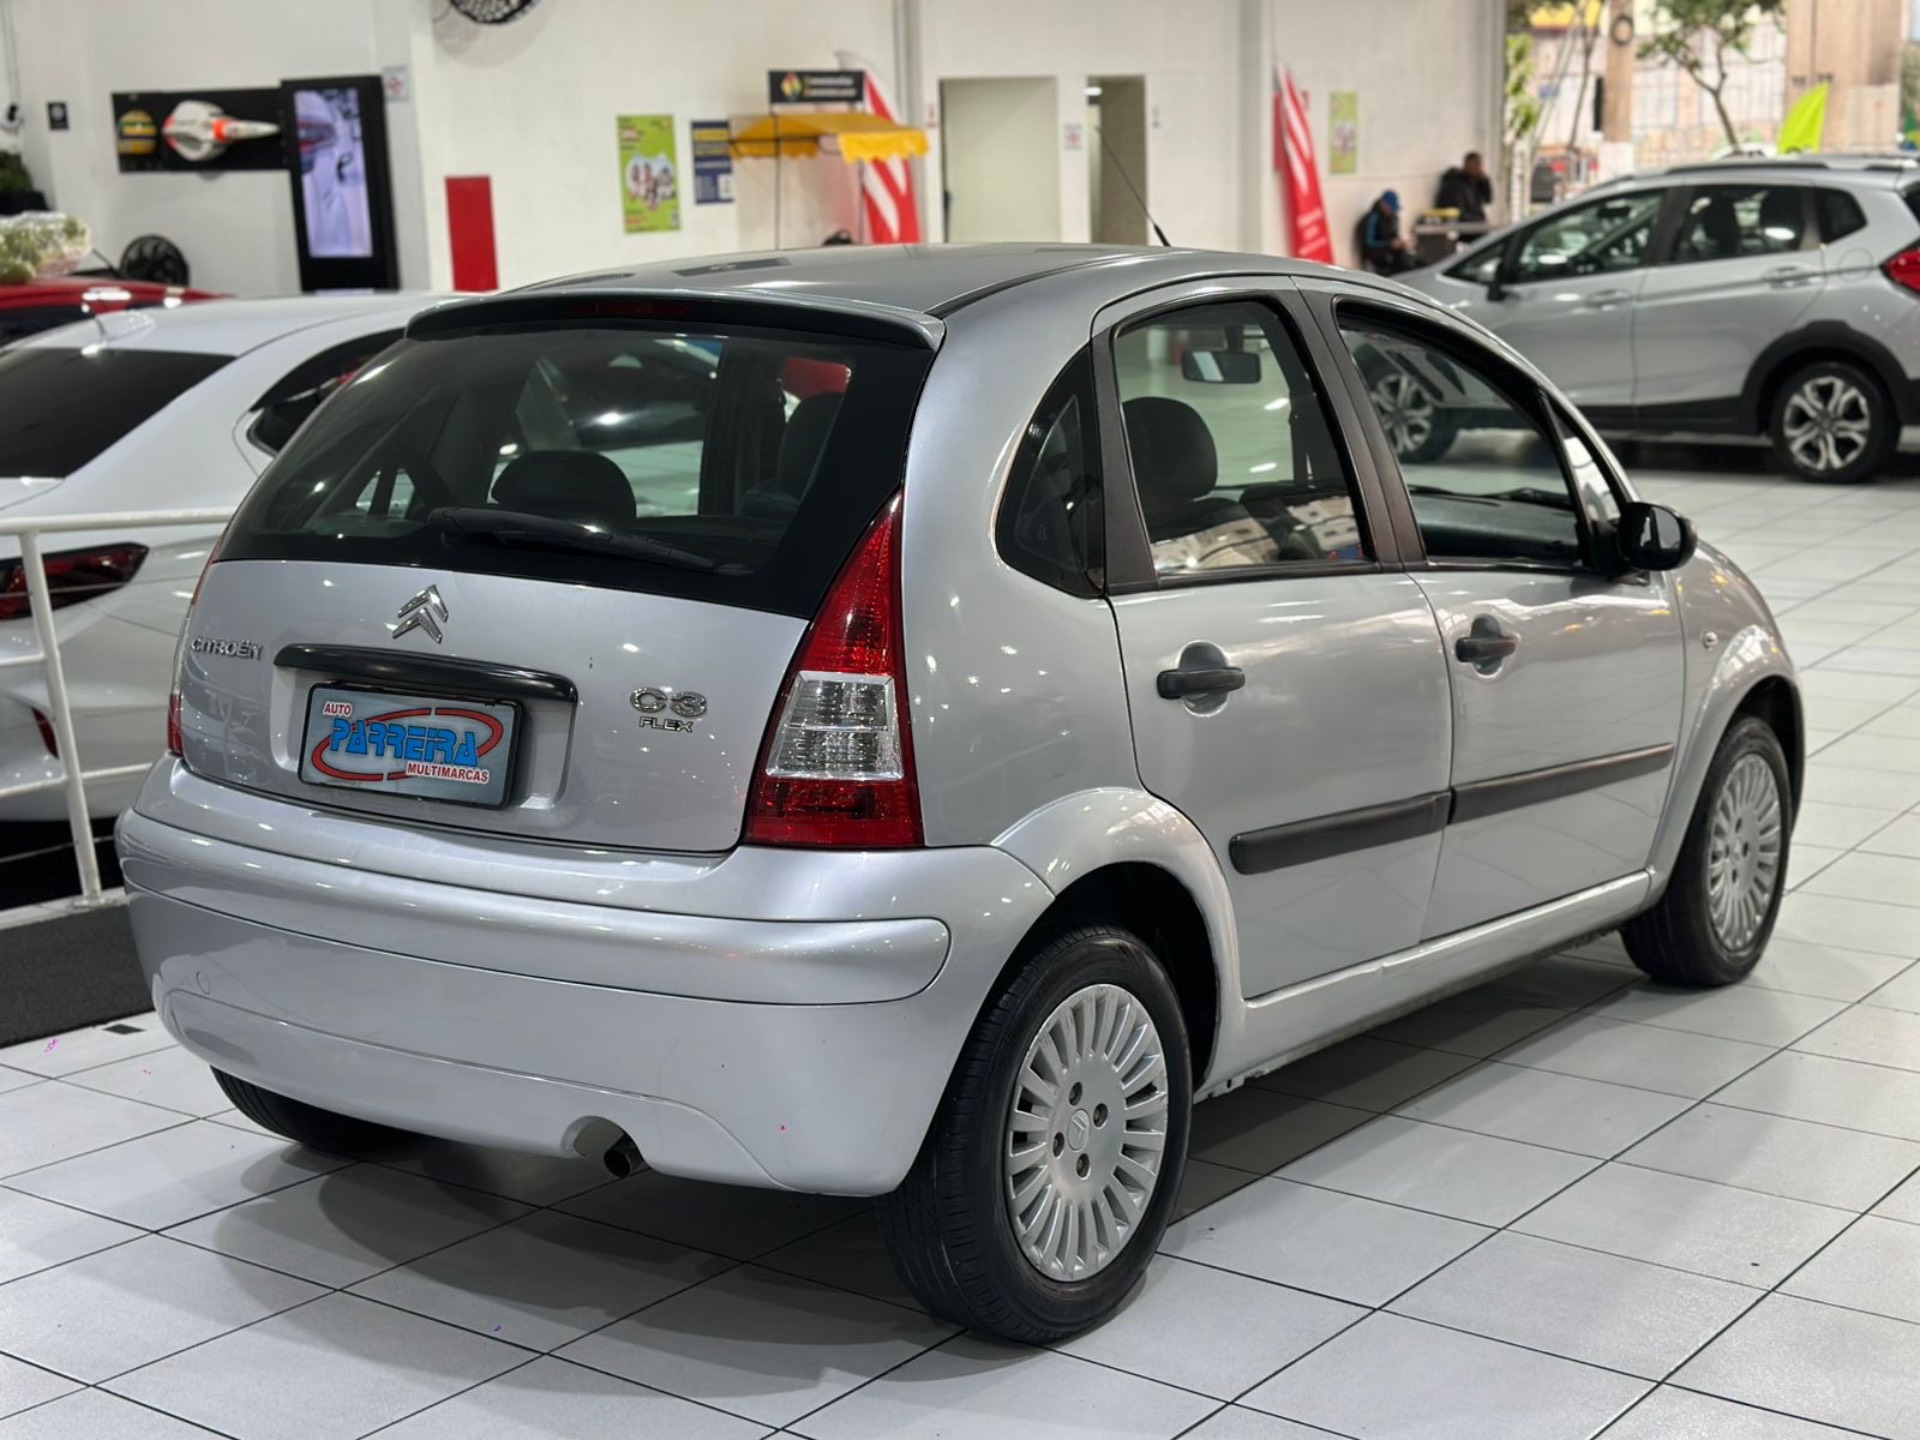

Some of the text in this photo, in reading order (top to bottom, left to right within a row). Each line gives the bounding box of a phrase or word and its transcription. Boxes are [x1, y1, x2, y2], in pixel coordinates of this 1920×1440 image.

[191, 638, 263, 661] CITROËN
[323, 702, 352, 716] AUTO
[630, 687, 707, 718] C3
[639, 716, 694, 733] FLEX
[330, 718, 478, 768] PARREIRA
[406, 762, 489, 783] MULTIMARCAS
